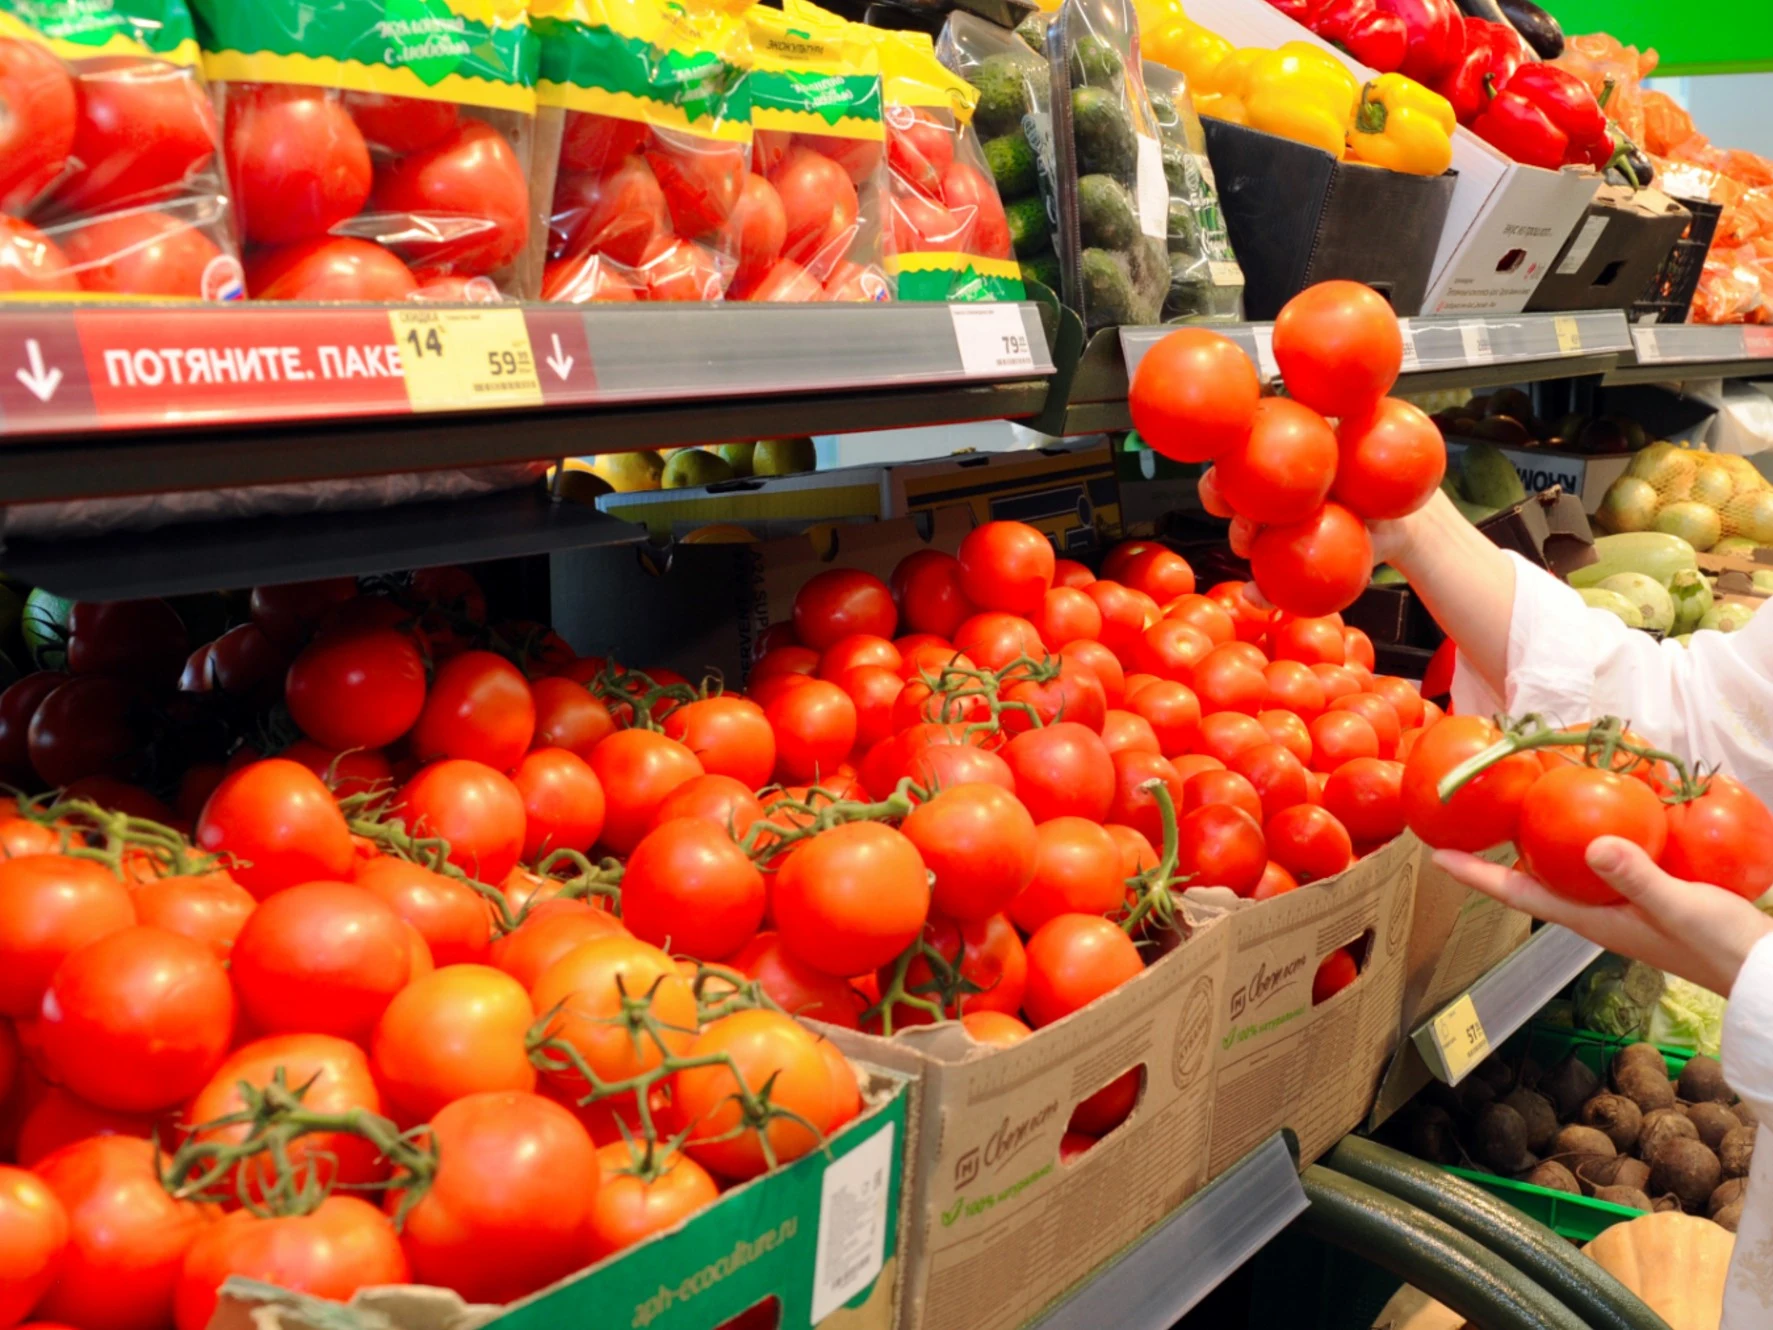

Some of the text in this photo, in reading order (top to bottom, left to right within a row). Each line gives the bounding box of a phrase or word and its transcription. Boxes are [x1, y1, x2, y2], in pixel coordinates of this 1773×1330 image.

[406, 327, 443, 358] 14
[1001, 335, 1020, 354] 79
[103, 345, 405, 387] ПОТЯНИТЕ. ПАКЕ
[488, 350, 517, 376] 59
